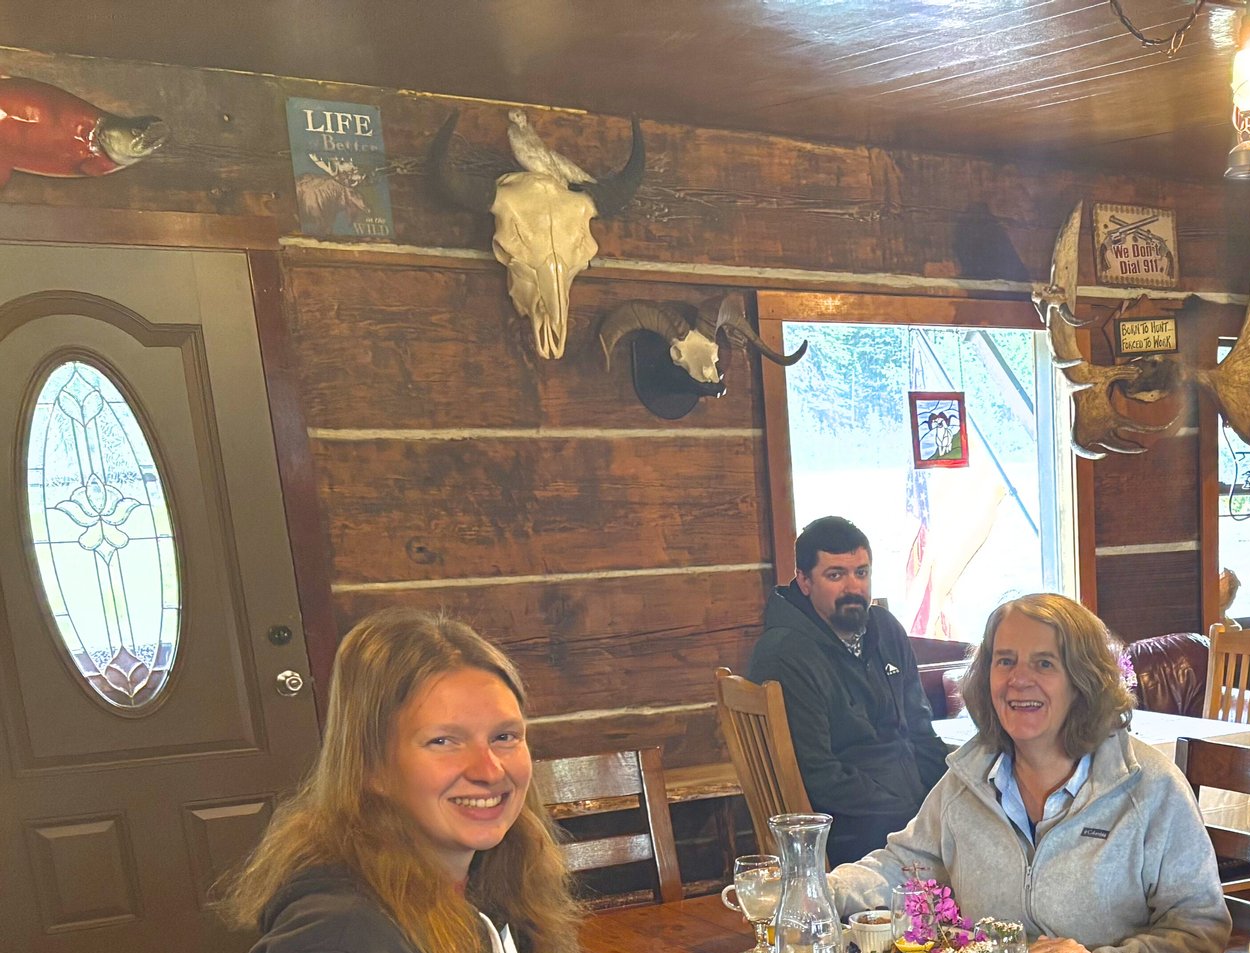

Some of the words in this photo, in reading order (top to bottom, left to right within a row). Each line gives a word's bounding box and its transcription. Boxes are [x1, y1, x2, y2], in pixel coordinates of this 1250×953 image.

[303, 109, 374, 136] LIFE
[353, 222, 390, 236] WILD
[1112, 244, 1129, 259] We
[1131, 243, 1160, 258] Don't
[1119, 259, 1141, 275] Dial
[1143, 258, 1159, 274] 911
